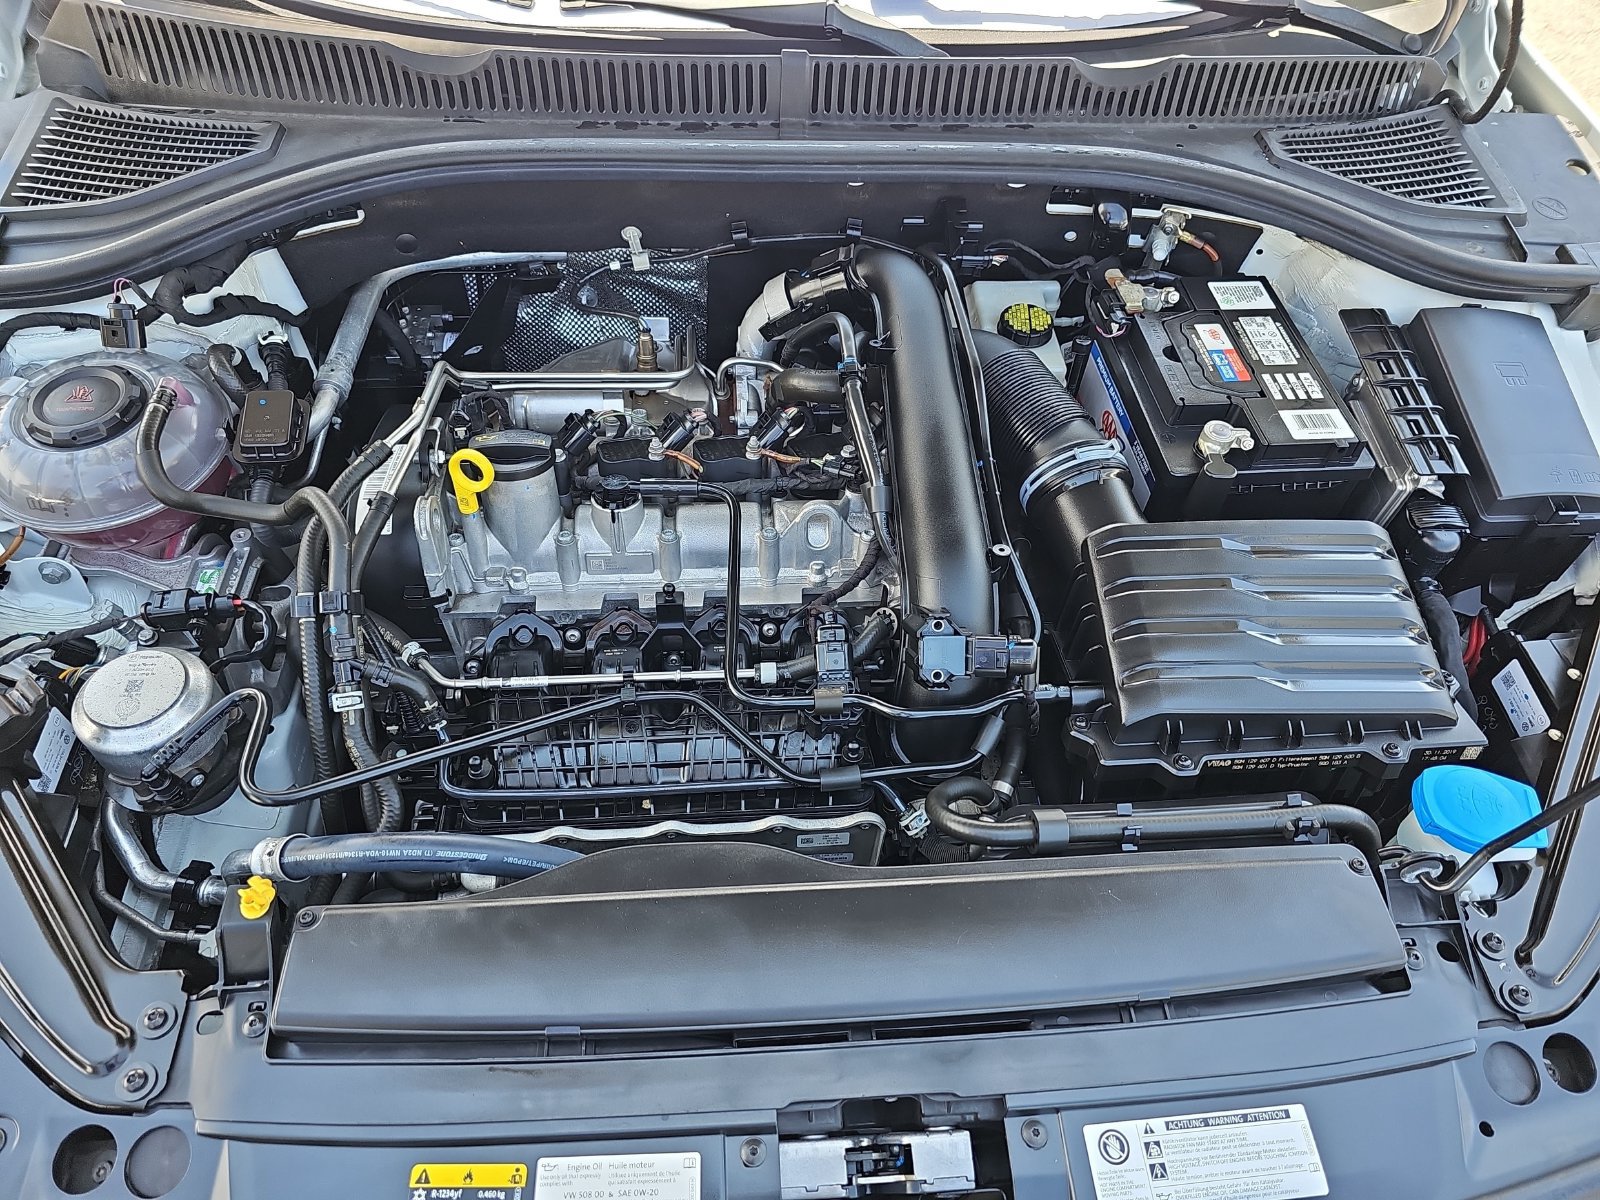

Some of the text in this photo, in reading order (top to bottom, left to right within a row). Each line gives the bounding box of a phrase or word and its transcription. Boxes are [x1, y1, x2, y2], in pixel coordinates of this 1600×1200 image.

[1096, 356, 1124, 417] PREMIUM BATTERY
[436, 850, 488, 860] BRIDGESTONE
[1168, 1110, 1286, 1130] ACHTUNG WARNING ATTENTION
[568, 1163, 591, 1172] Engine
[592, 1162, 602, 1170] Oil
[609, 1161, 627, 1169] Huile
[432, 1189, 462, 1200] R-1234yf
[497, 1190, 505, 1200] kg
[579, 1190, 592, 1198] 508
[594, 1190, 604, 1198] 00
